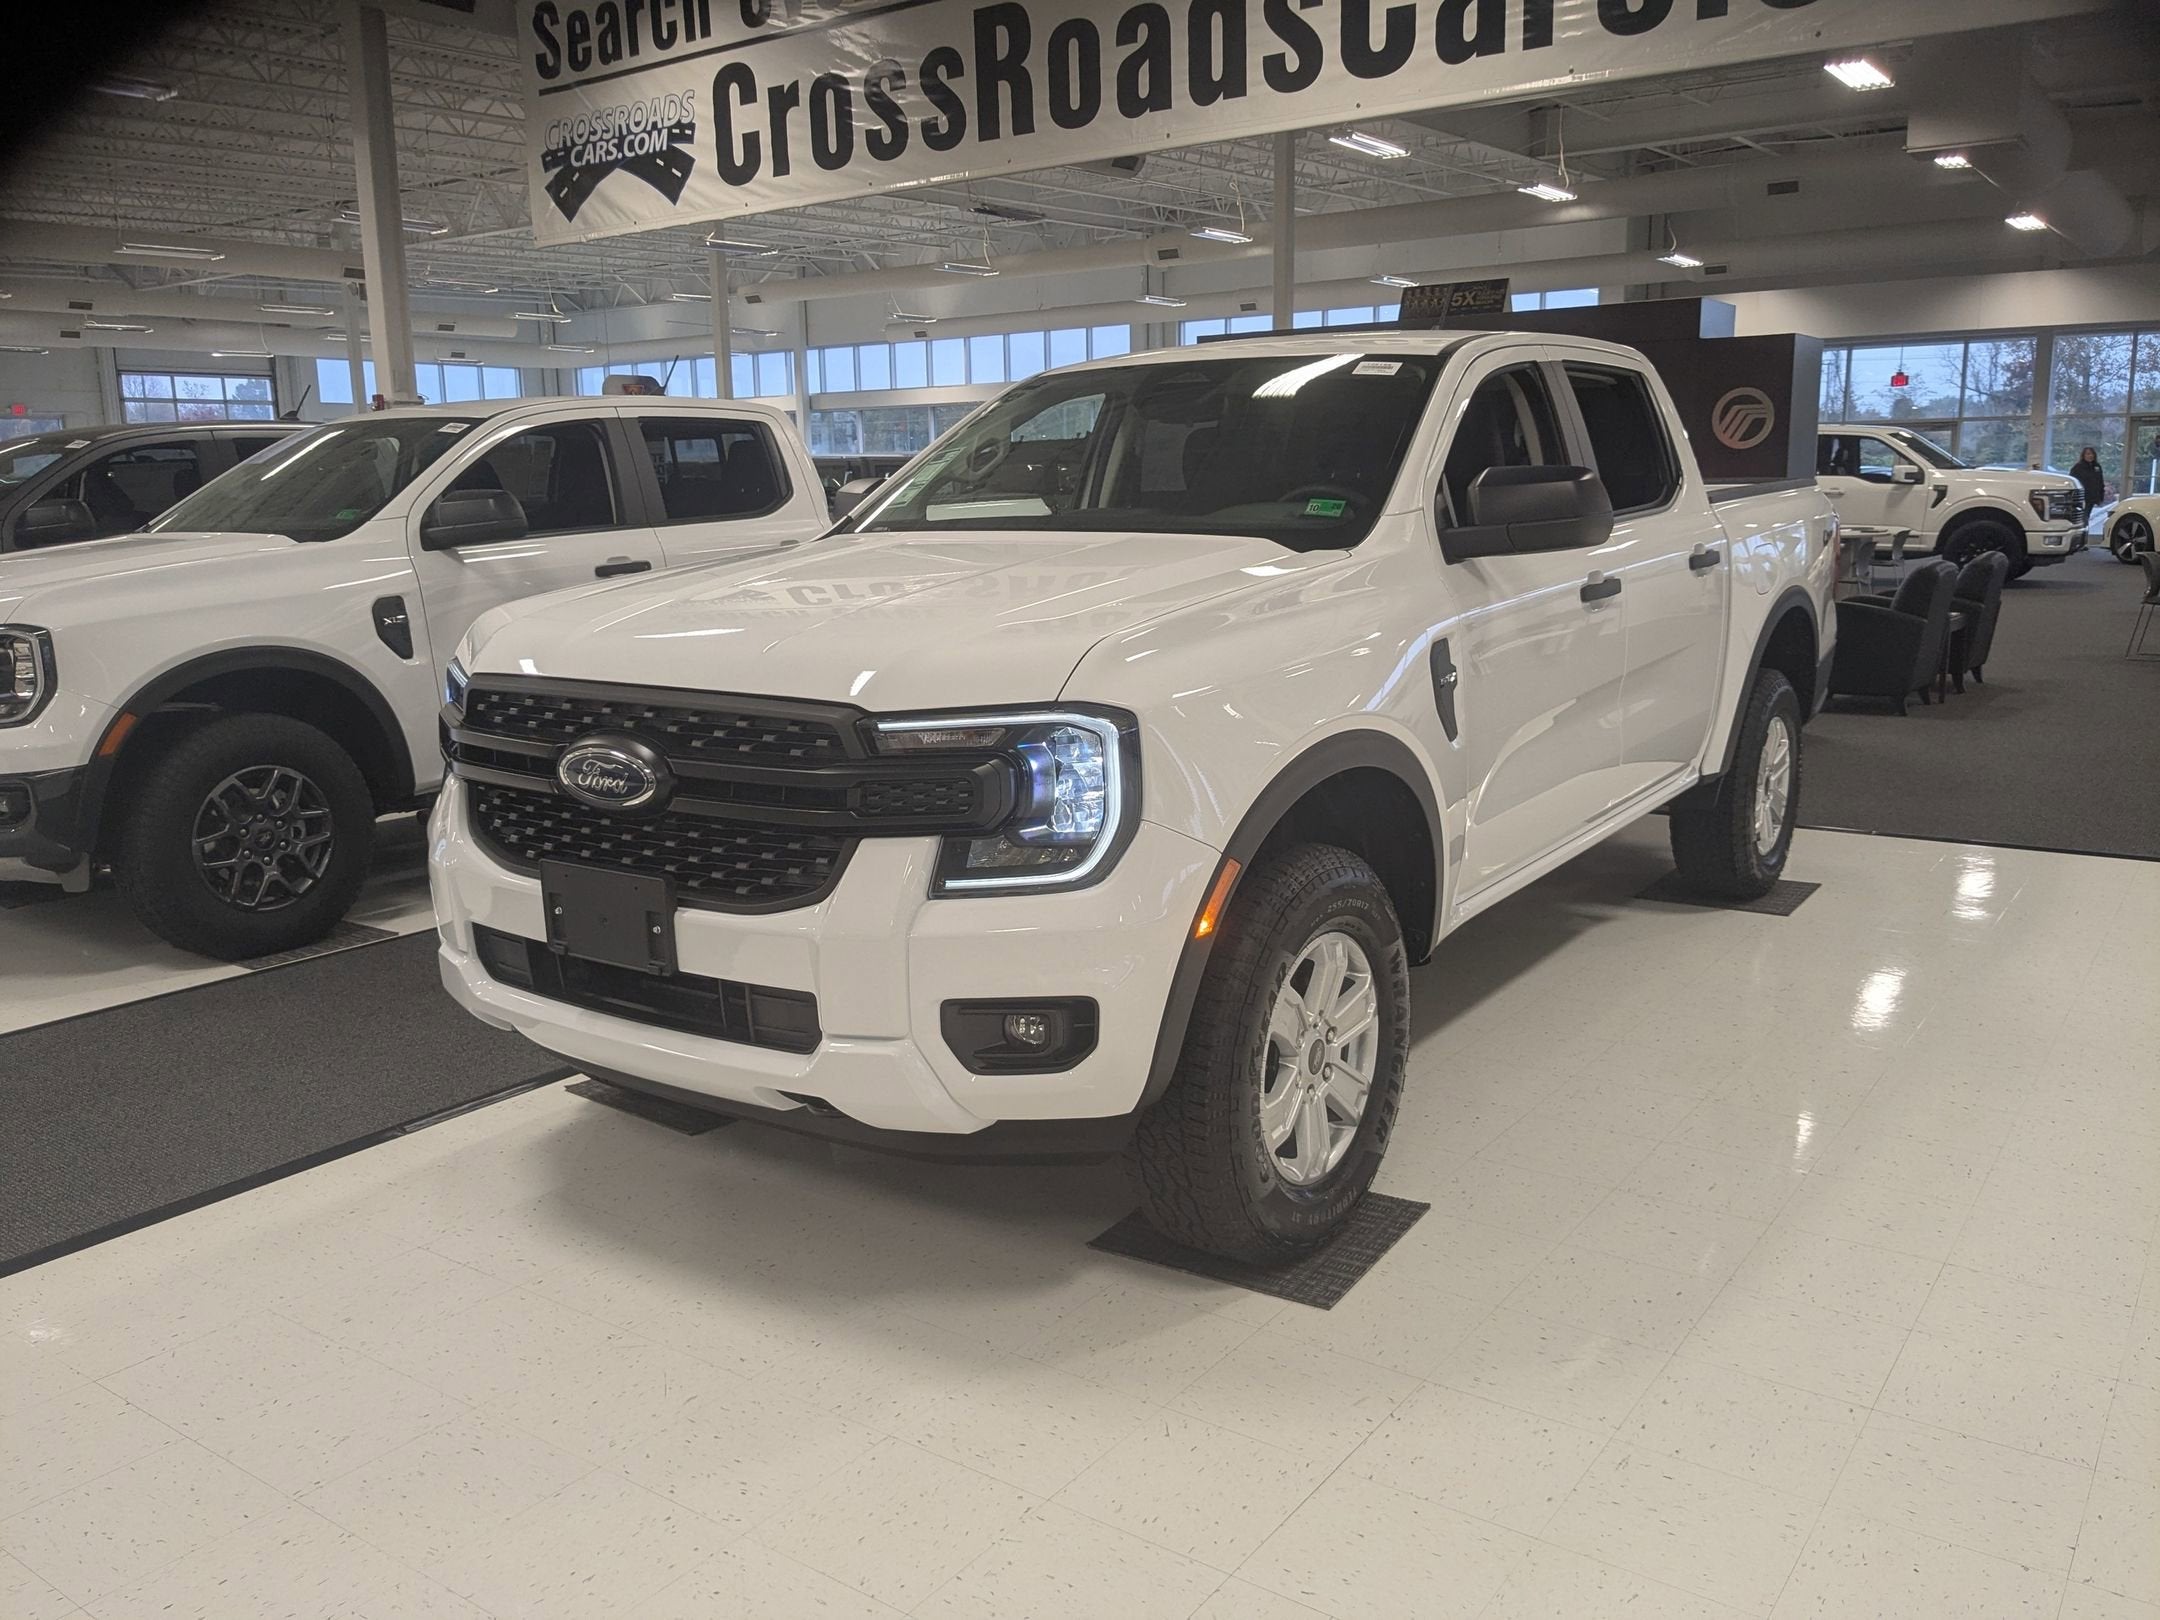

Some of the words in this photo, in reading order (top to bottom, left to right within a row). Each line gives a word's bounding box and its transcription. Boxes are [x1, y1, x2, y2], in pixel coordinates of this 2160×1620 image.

[545, 89, 695, 150] CROSSROADS
[570, 128, 668, 168] CARS.COM
[1450, 292, 1477, 307] 5X
[578, 759, 629, 794] Ford
[1374, 946, 1407, 1145] WRANGLER
